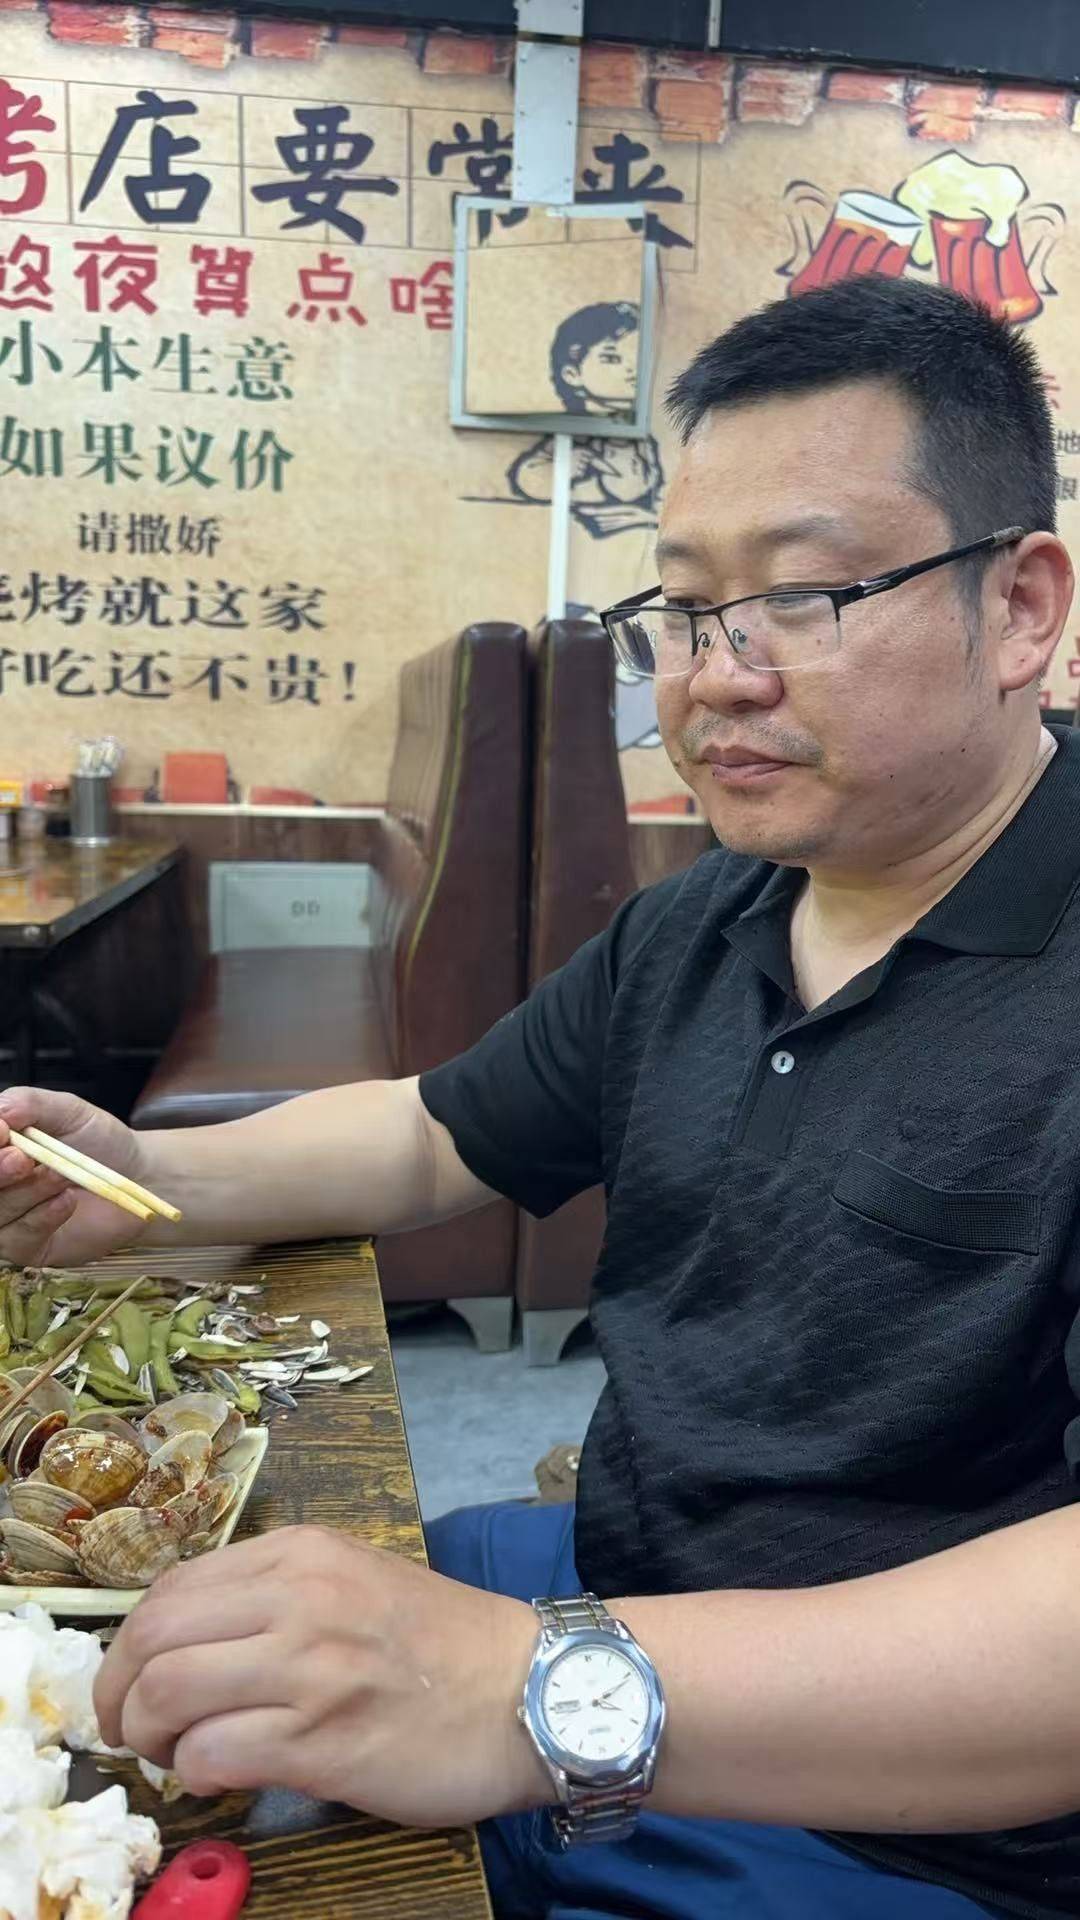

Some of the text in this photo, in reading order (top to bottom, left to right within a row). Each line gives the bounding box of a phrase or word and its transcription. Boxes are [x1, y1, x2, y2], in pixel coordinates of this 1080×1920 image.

[0, 320, 294, 401] 小本生意
[0, 416, 294, 492] 如果议价
[78, 511, 222, 558] 请撒娇
[0, 572, 327, 632] 烤就这家
